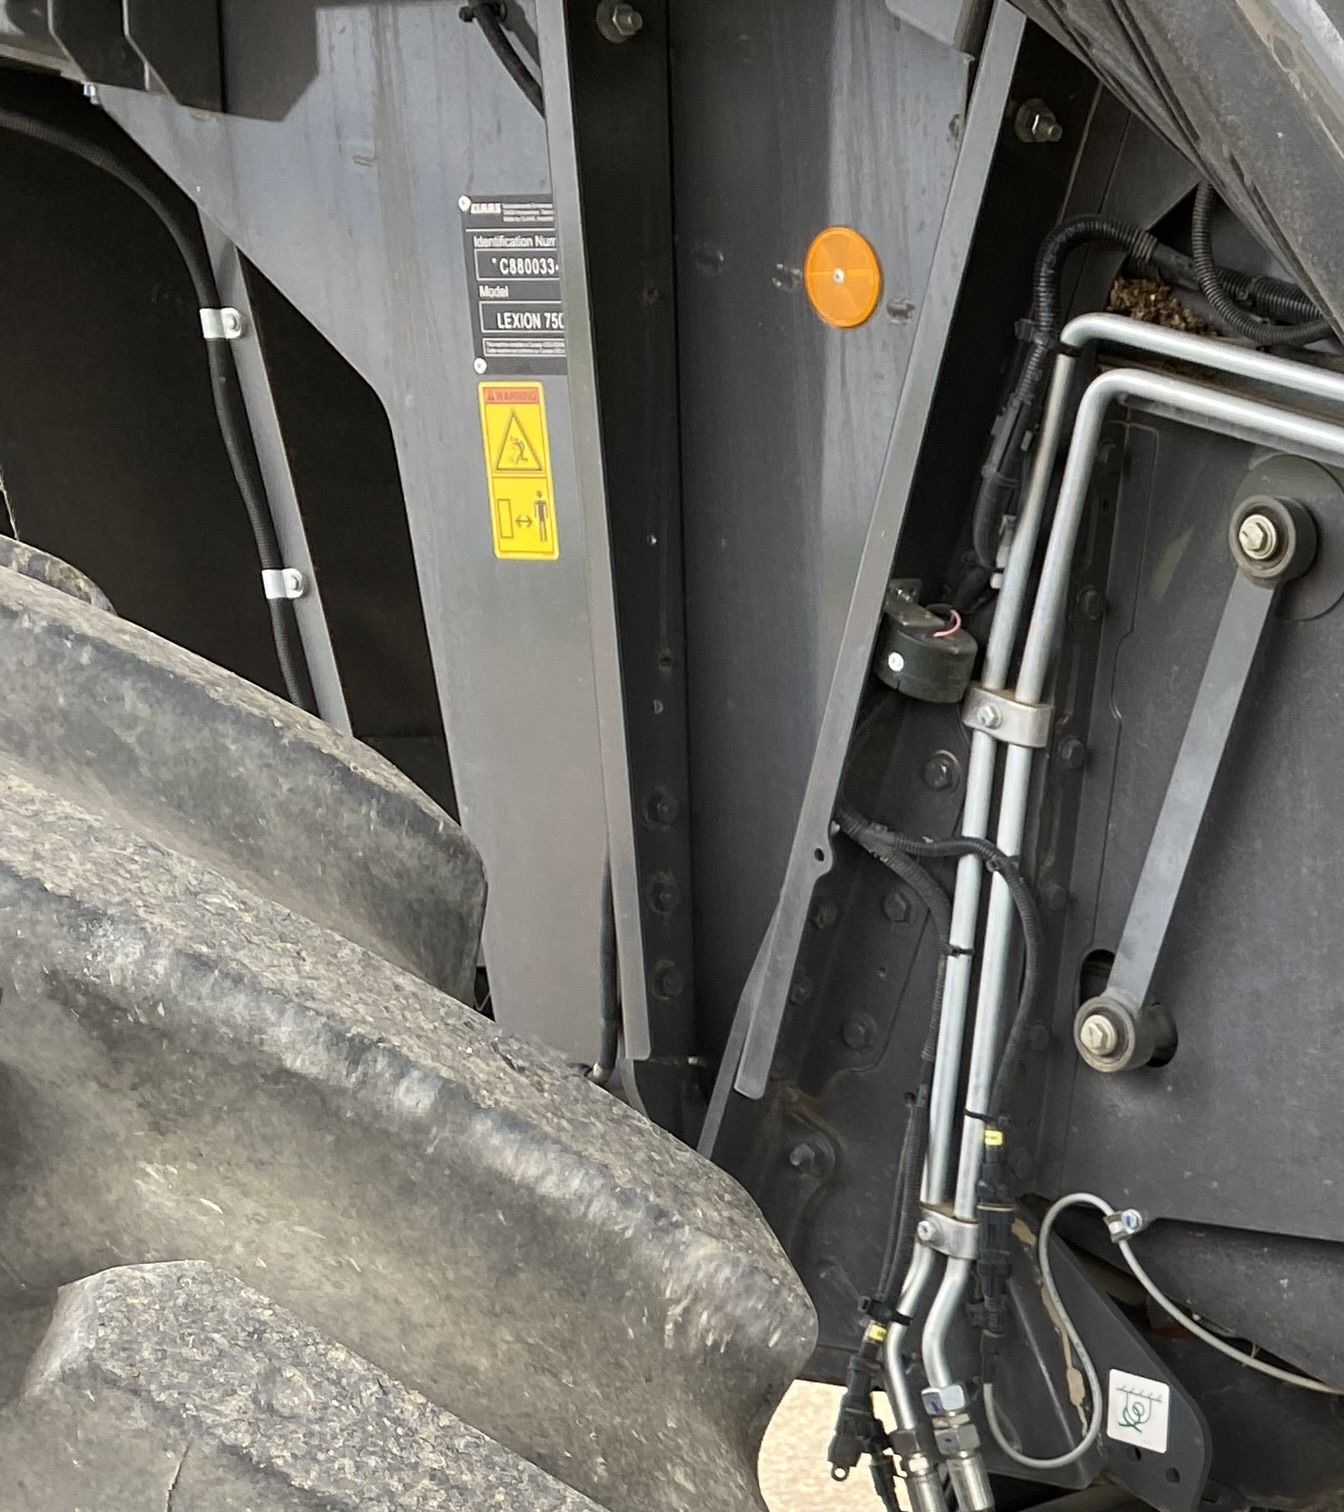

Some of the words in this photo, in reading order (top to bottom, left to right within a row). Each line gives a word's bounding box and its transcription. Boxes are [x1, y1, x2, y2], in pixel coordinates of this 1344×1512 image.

[474, 235, 533, 247] Identification
[500, 258, 559, 274] C880033
[479, 285, 509, 297] Model
[497, 312, 542, 329] LEXION
